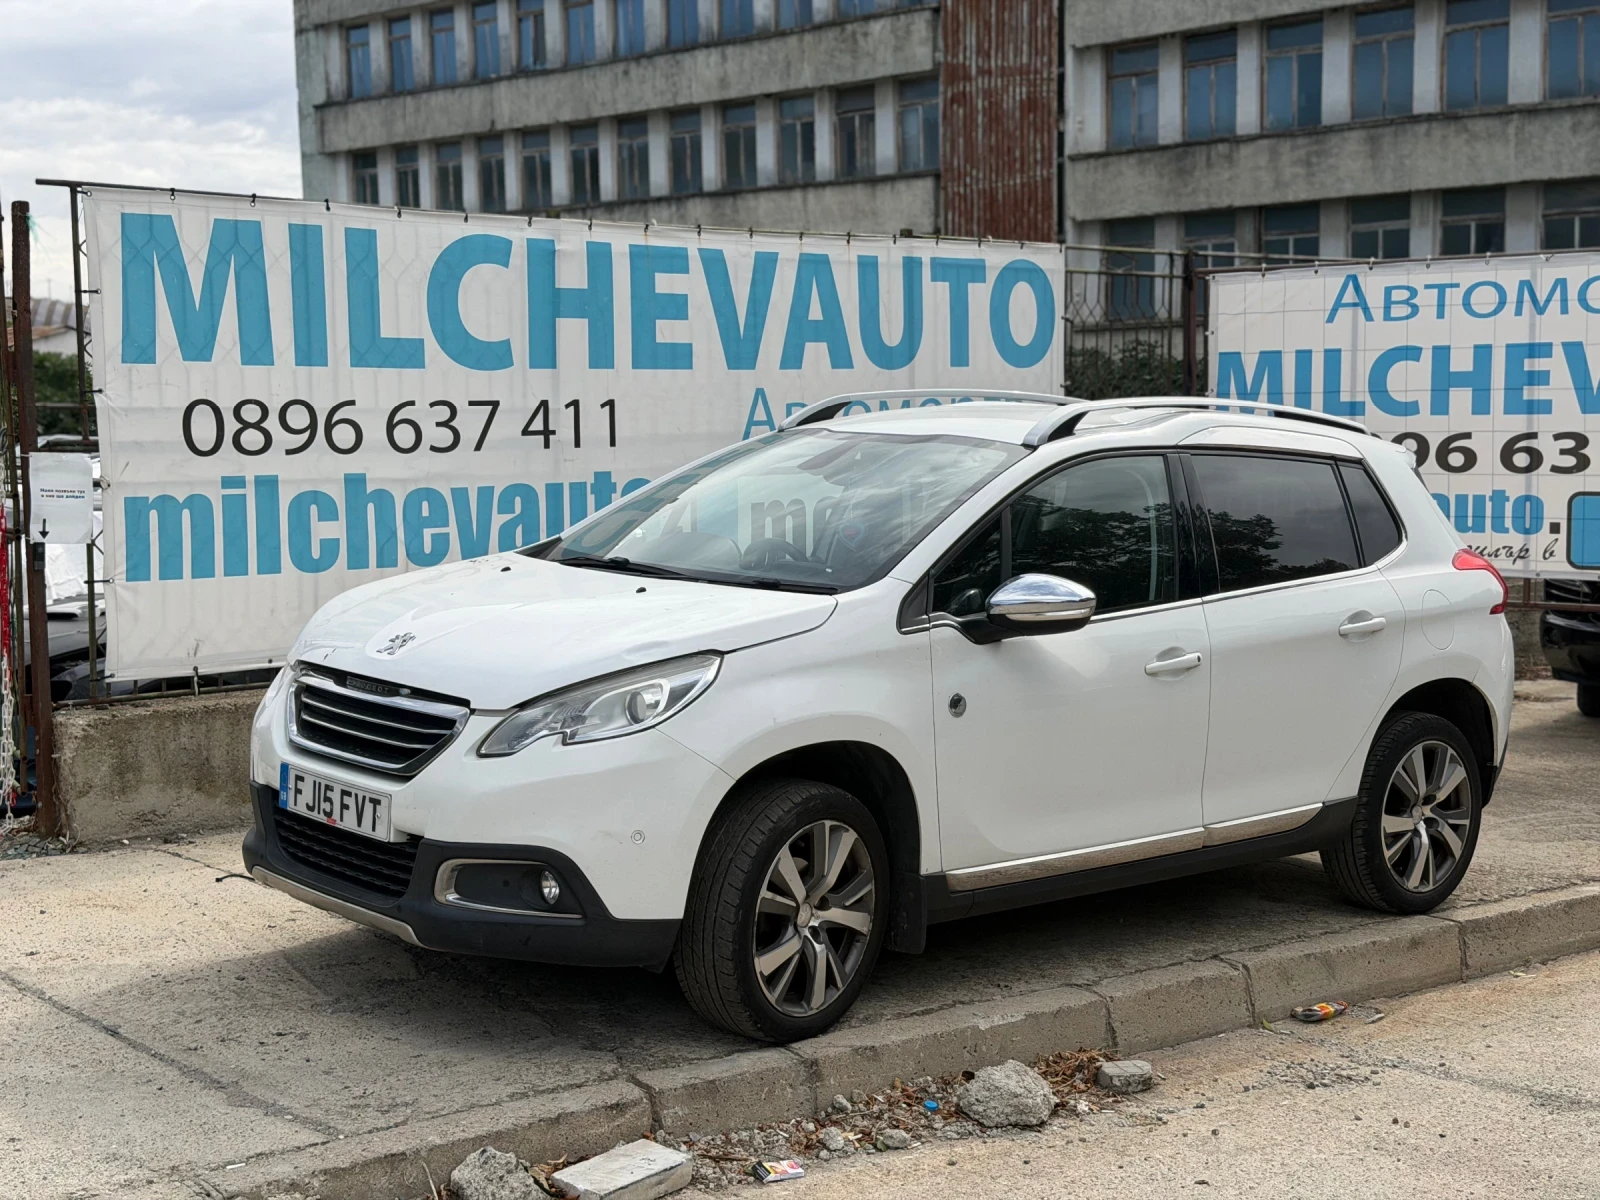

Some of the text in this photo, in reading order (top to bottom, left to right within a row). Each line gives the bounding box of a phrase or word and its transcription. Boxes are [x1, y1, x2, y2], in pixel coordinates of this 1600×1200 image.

[120, 211, 1056, 371] MILCHEVAUTO
[182, 398, 618, 457] 0896 637 411
[293, 774, 382, 833] FJ15 FVT
